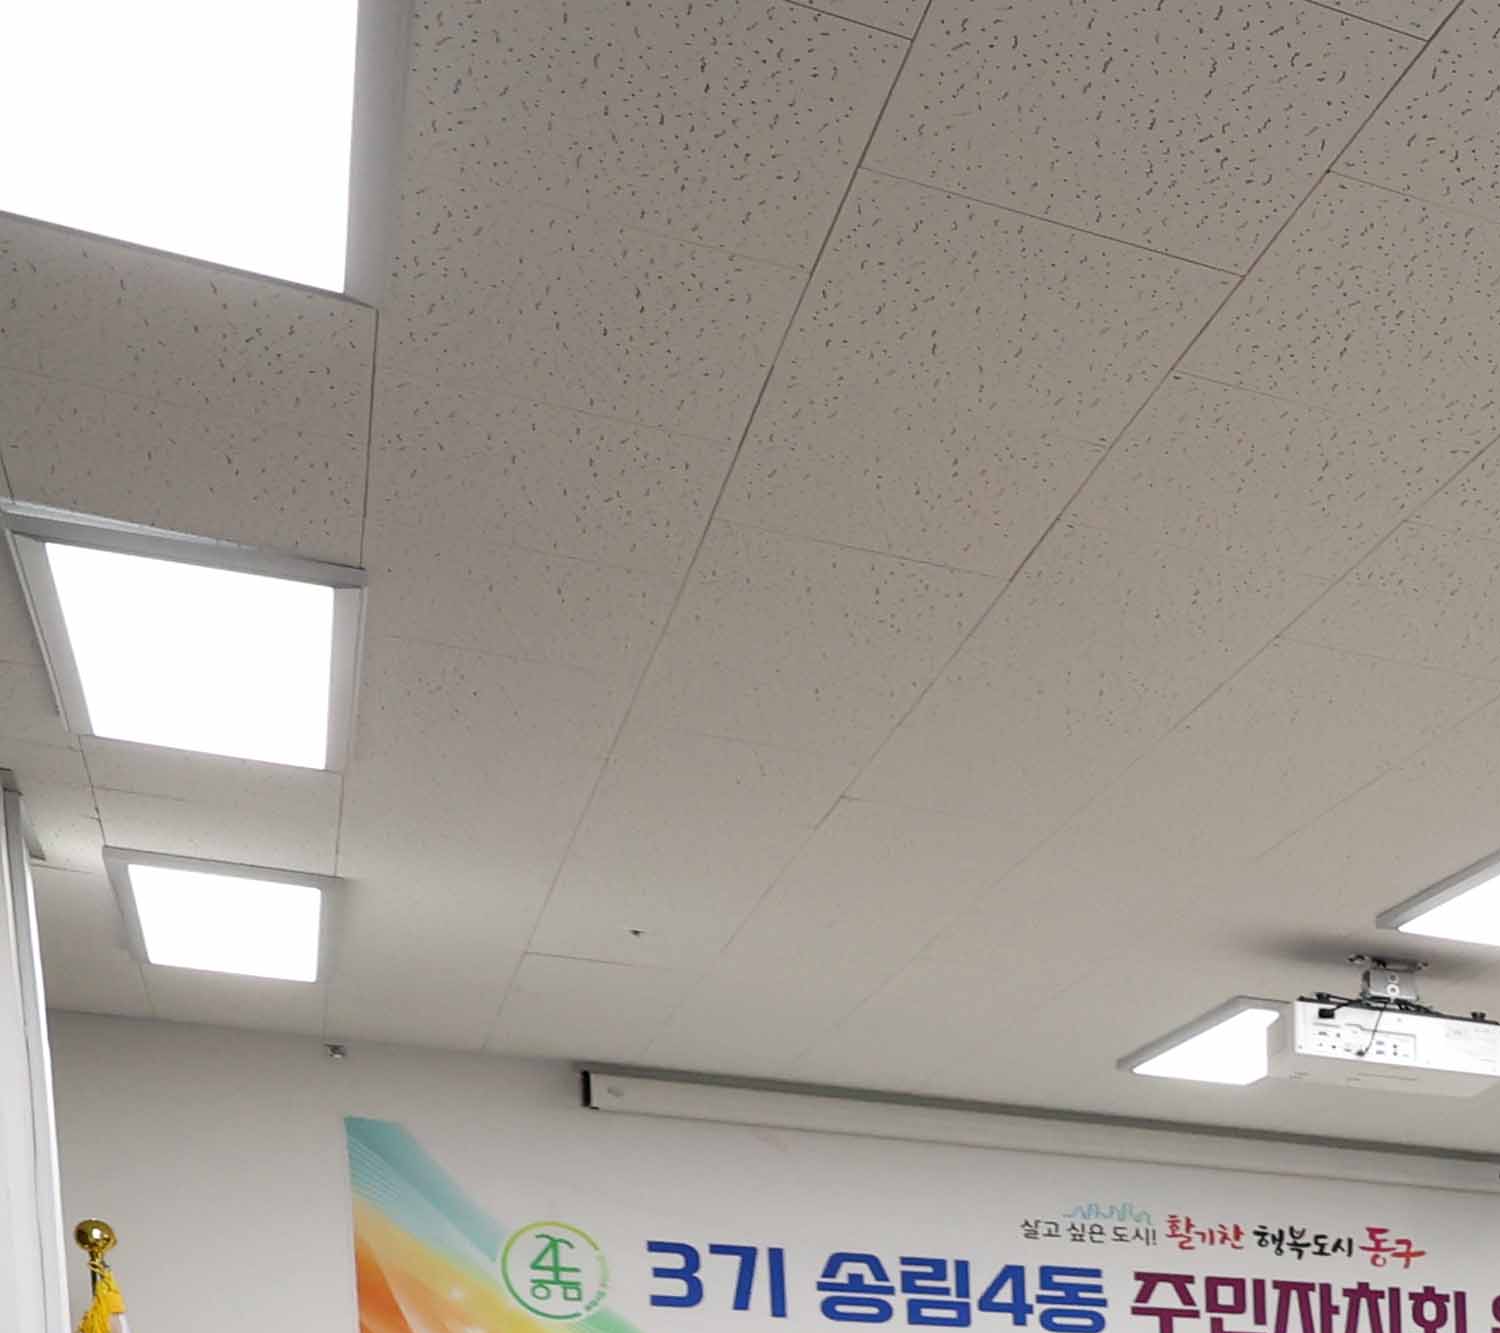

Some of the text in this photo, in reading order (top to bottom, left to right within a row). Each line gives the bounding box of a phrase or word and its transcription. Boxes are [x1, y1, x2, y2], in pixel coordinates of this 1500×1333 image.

[1020, 1219, 1062, 1241] 살고
[1067, 1221, 1105, 1245] 싶은
[1111, 1225, 1157, 1247] 도시!
[1165, 1214, 1246, 1251] 활기찬
[1359, 1226, 1426, 1269] 동구
[647, 1240, 789, 1319] 3기
